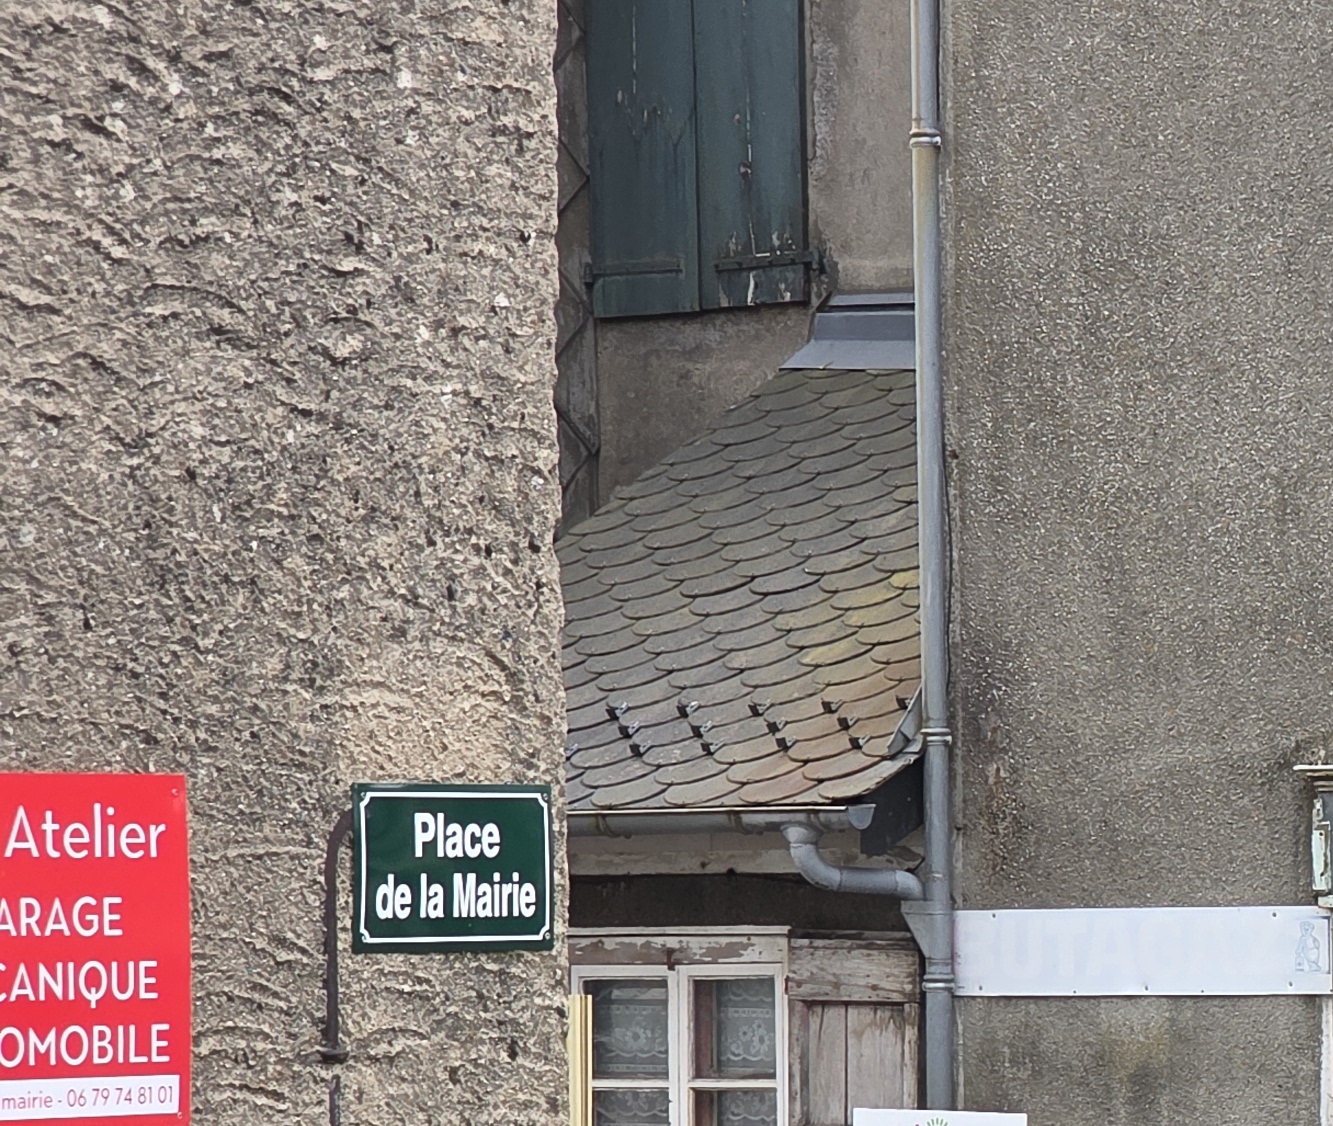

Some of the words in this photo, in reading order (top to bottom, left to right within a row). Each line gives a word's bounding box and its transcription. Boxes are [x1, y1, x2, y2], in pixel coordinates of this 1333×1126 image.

[4, 802, 167, 859] Atelier
[414, 812, 500, 858] Place
[376, 873, 412, 919] de
[420, 873, 444, 918] la
[453, 872, 536, 917] Mairie
[0, 1024, 170, 1068] OMOBILE
[1, 1090, 53, 1110] mairie
[66, 1088, 87, 1107] 06
[92, 1088, 110, 1106] 79
[115, 1087, 132, 1105] 74
[137, 1086, 153, 1105] 81
[157, 1085, 173, 1104] 01
